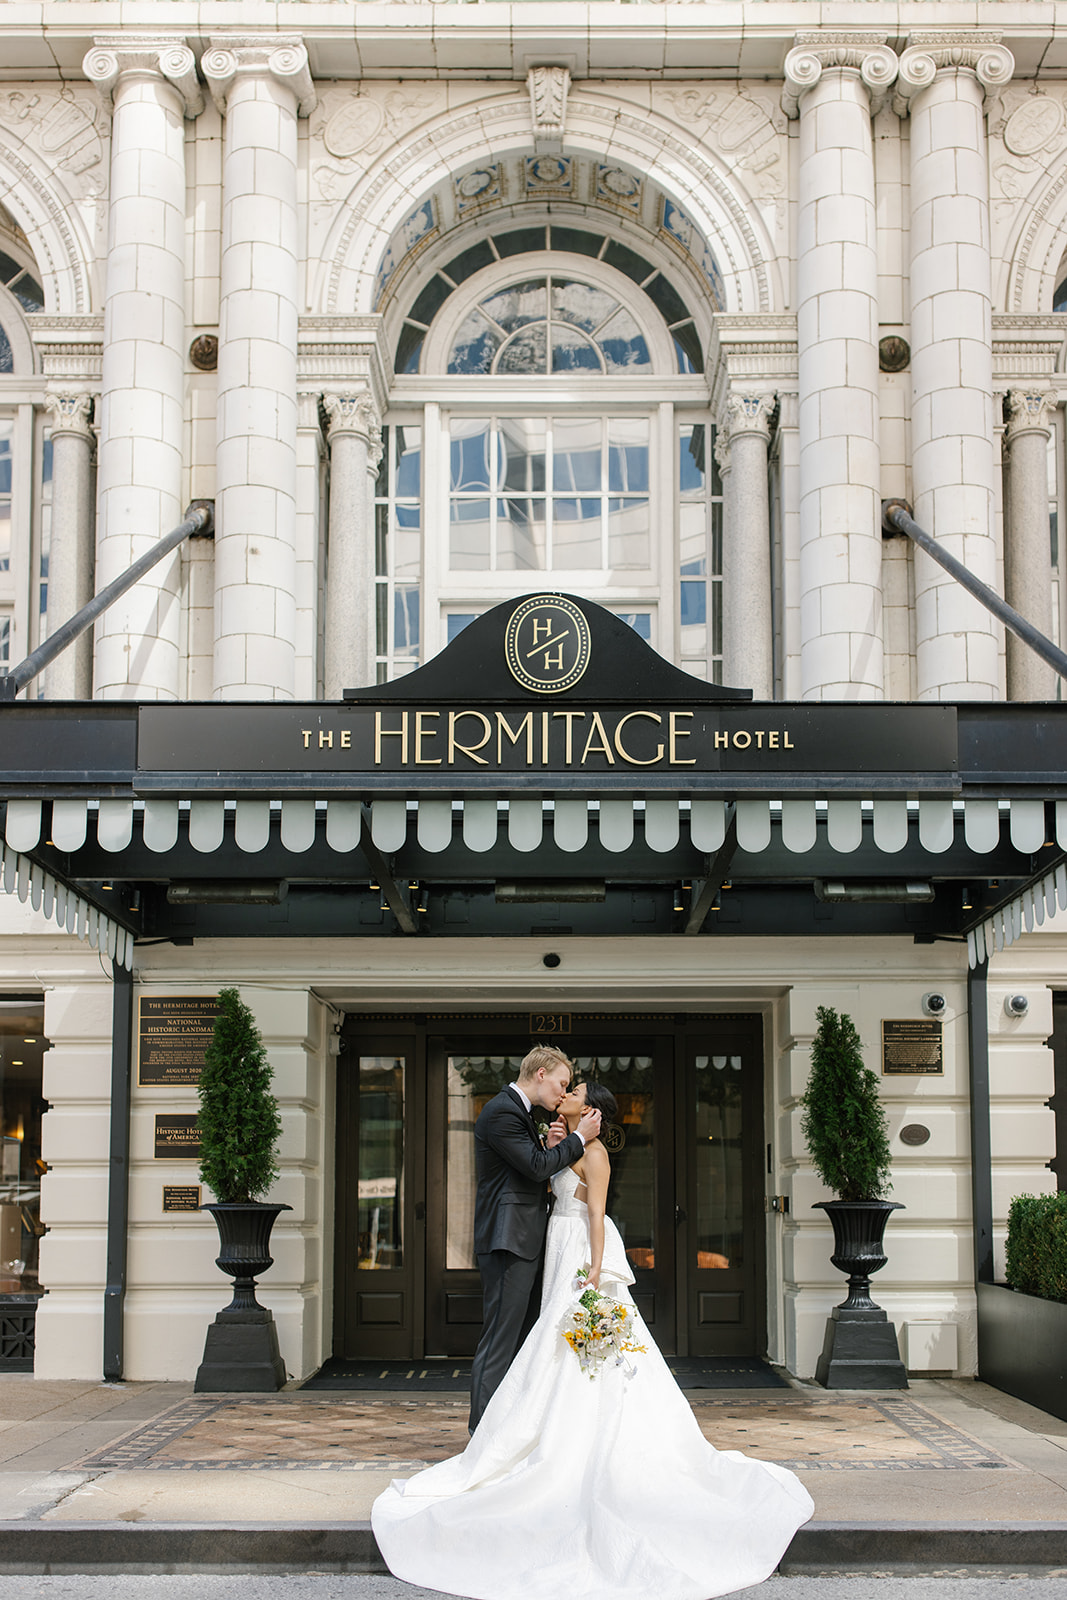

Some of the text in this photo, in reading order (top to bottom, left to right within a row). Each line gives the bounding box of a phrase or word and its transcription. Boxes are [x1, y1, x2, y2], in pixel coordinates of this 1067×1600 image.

[301, 710, 795, 765] THE HERMITAGE HOTEL
[535, 1014, 563, 1032] 231
